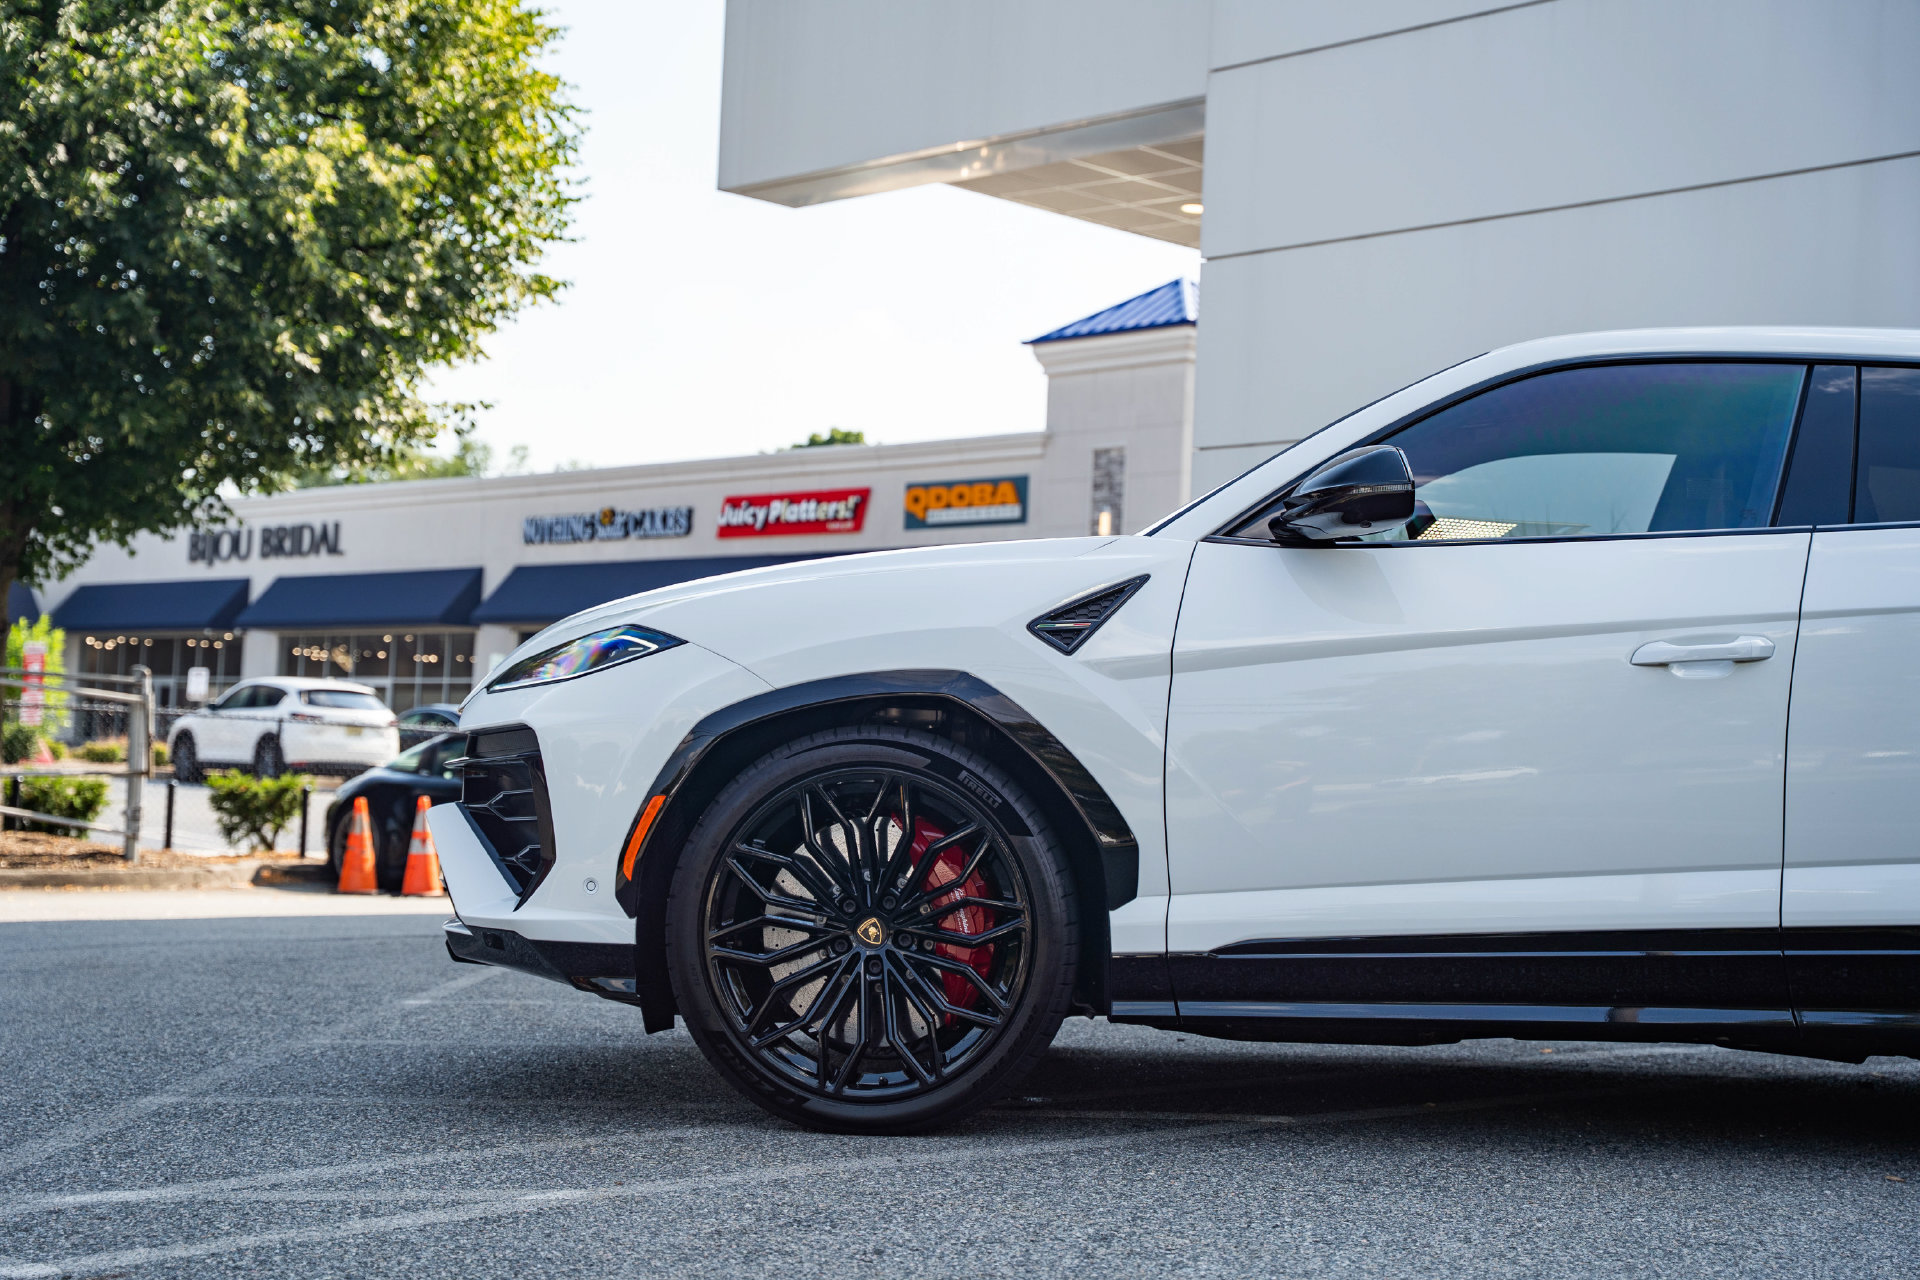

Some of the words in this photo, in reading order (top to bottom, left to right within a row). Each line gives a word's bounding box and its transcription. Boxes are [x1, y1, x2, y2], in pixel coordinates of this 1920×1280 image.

[718, 501, 768, 531] Juicy
[904, 481, 1019, 521] QDOBA
[189, 528, 252, 567] BIJOU
[260, 521, 344, 558] BRIDAL
[957, 770, 1003, 809] PIRELLI
